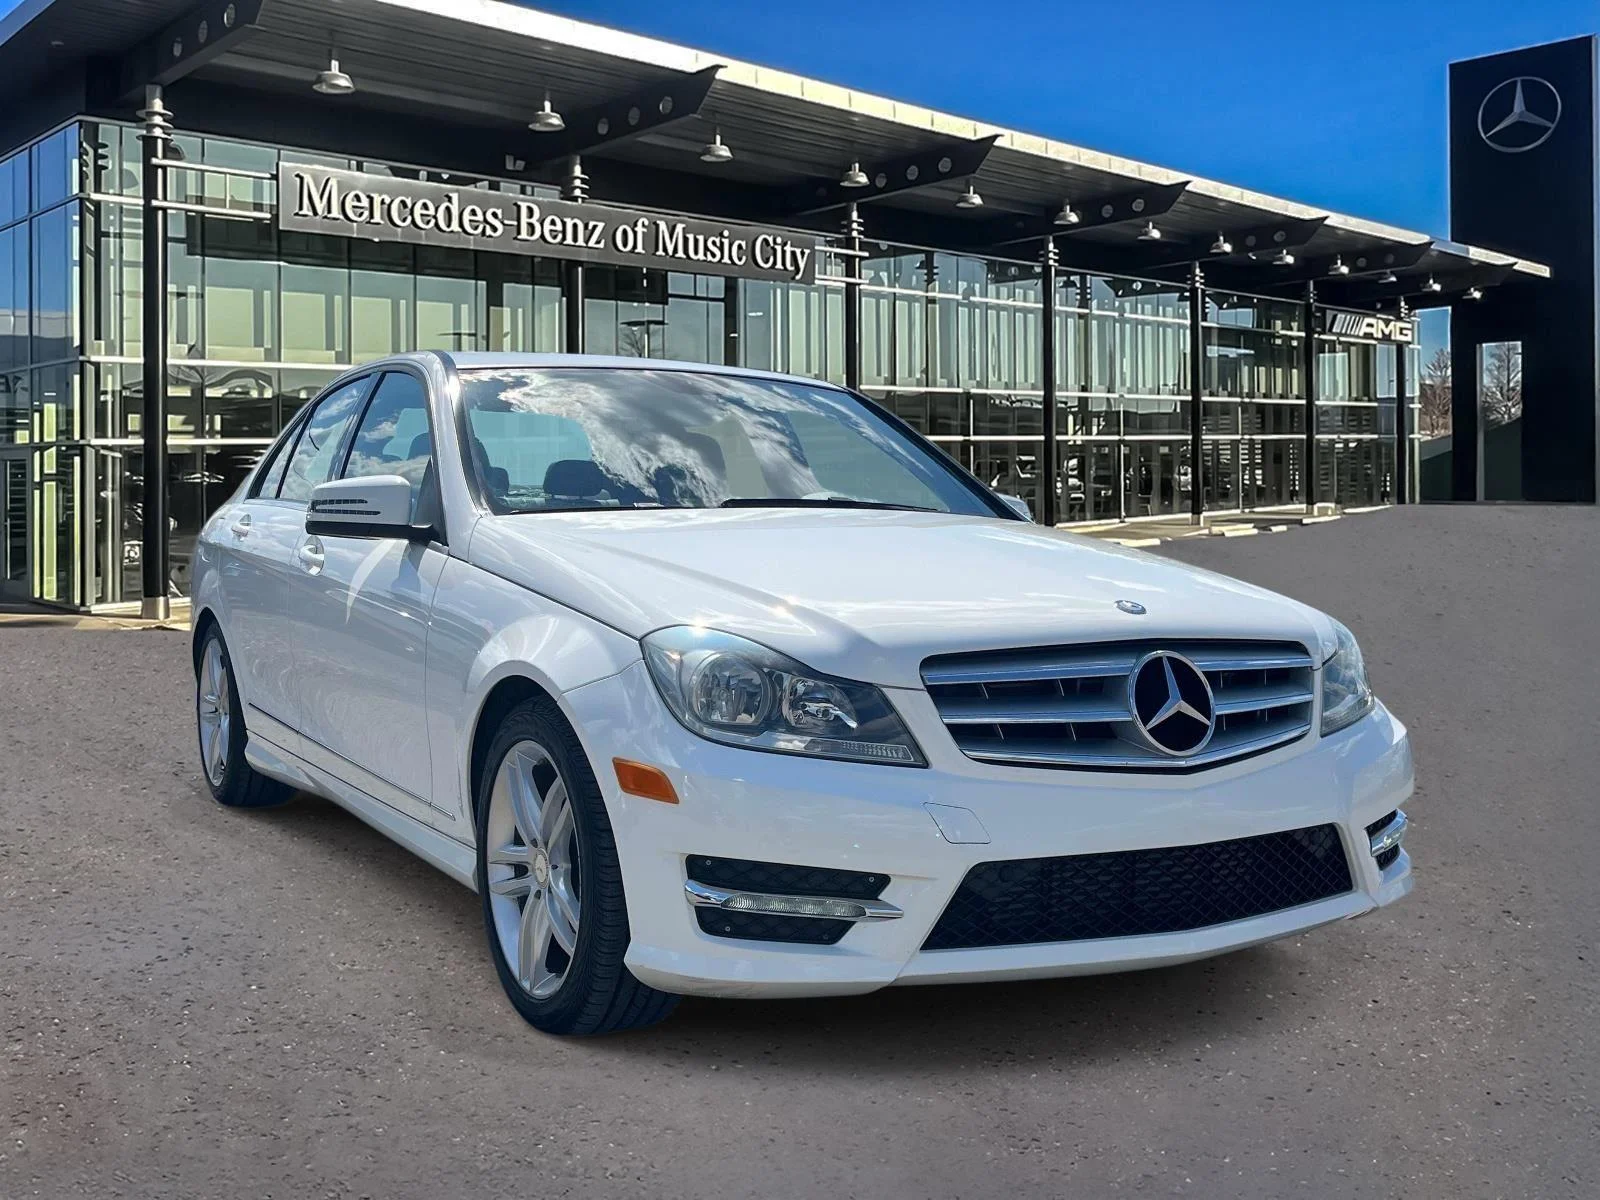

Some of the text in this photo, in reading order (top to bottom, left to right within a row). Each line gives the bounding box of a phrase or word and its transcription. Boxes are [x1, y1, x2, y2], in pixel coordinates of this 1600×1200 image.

[295, 173, 811, 280] Mercedes-Benz of Music City
[1359, 317, 1412, 342] AMG
